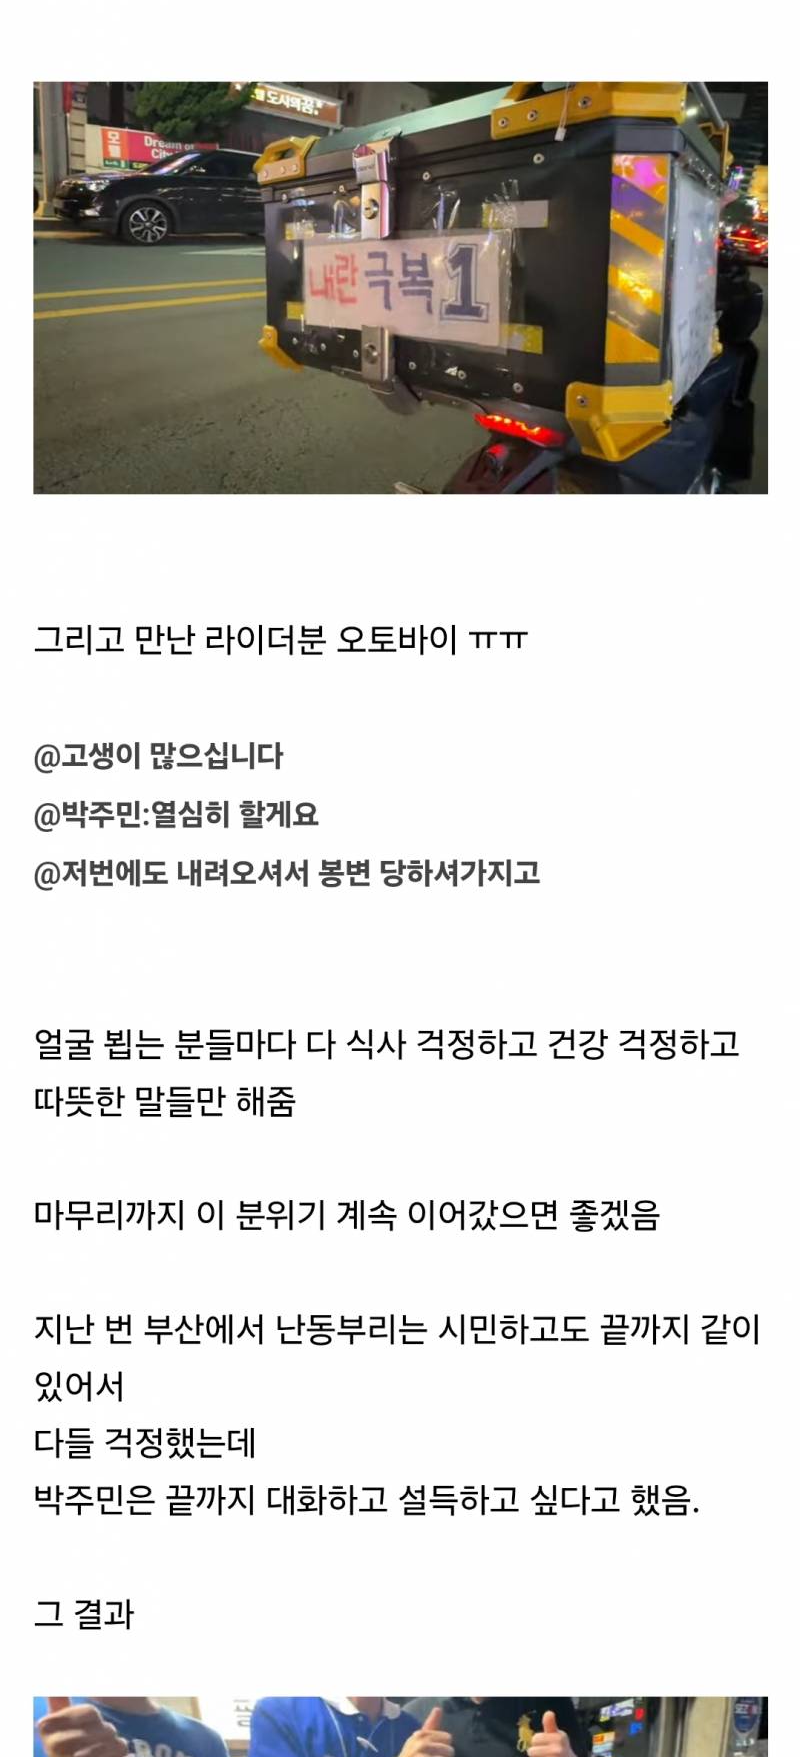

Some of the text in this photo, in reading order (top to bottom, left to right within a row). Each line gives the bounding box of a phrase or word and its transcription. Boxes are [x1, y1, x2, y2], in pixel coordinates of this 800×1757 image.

[143, 135, 181, 150] Dream
[309, 242, 489, 323] 내란 극복 1
